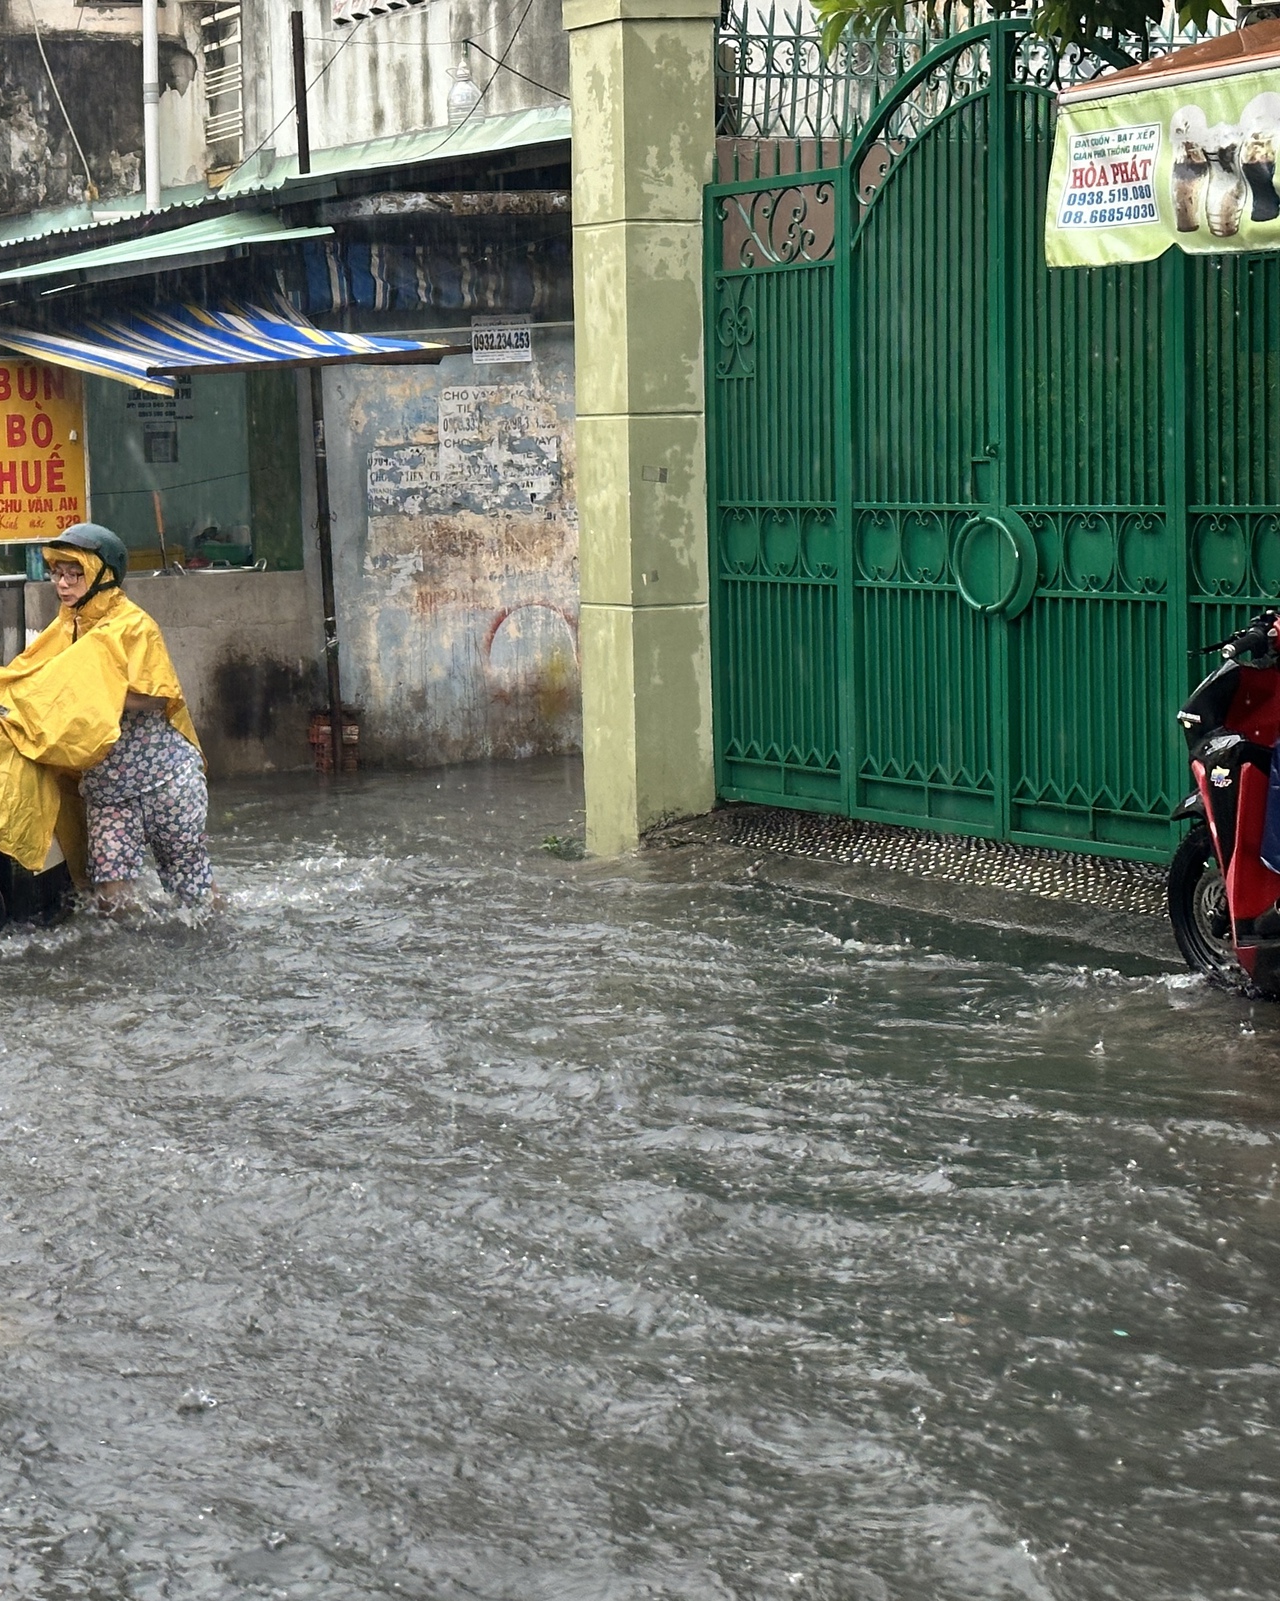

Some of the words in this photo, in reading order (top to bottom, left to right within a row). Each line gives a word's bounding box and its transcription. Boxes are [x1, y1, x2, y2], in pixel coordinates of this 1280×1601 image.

[1137, 129, 1155, 140] XẾP
[1132, 143, 1154, 153] MINH
[1070, 161, 1109, 189] HÒA
[1110, 154, 1151, 185] PHÁT
[1066, 184, 1152, 206] 0938.519.080
[1062, 203, 1155, 224] 08.66854030
[473, 331, 530, 351] 0932.234.253
[5, 401, 53, 449] BÒ
